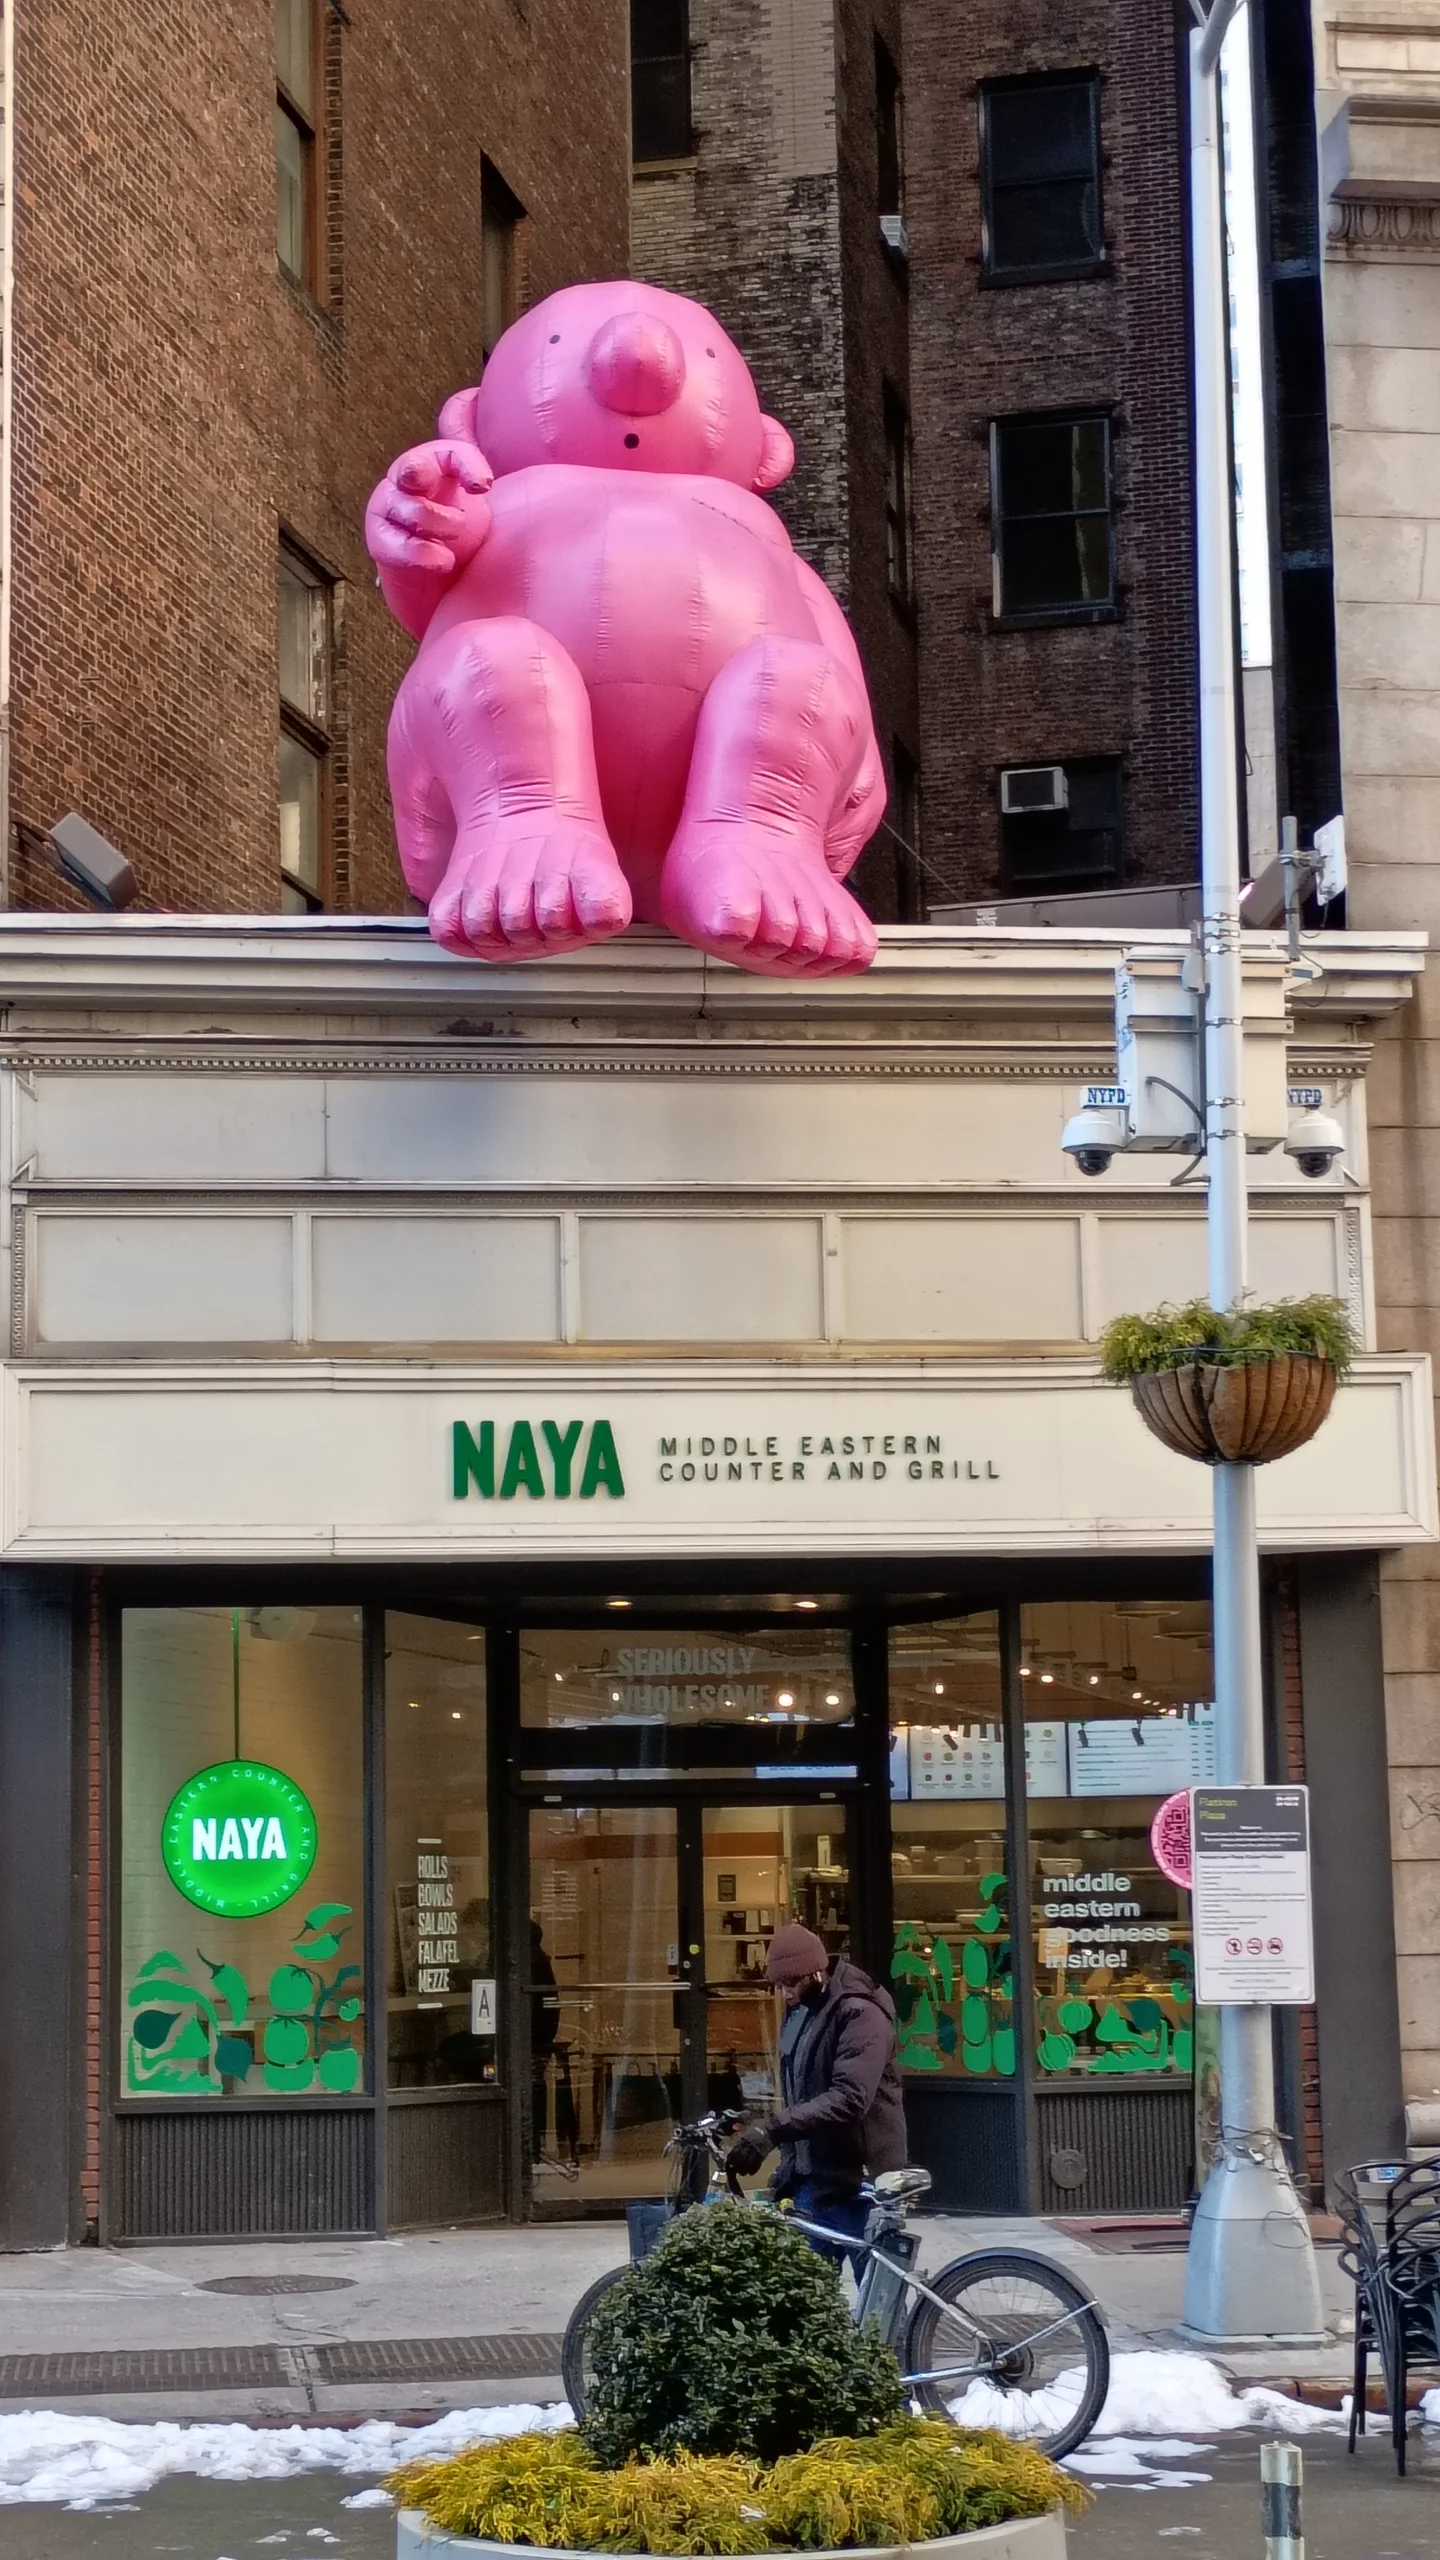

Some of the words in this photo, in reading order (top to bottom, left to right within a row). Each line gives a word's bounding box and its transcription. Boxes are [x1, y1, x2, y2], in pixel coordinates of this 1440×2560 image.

[1087, 1087, 1126, 1104] NYPD
[659, 1437, 779, 1456] MIDDLE
[801, 1436, 942, 1456] EASTERN
[453, 1420, 625, 1499] NAYA
[659, 1461, 806, 1481] COUNTER
[827, 1461, 887, 1480] AND
[908, 1460, 1001, 1479] GRILL
[617, 1647, 756, 1676] SERIOUSLY
[192, 1817, 287, 1861] NAYA
[418, 1856, 448, 1879] ROLLS
[1043, 1873, 1131, 1892] middle
[418, 1884, 453, 1907] BOWLS
[1044, 1900, 1140, 1918] eastern
[418, 1912, 458, 1935] SALADS
[1045, 1924, 1170, 1947] goodness
[418, 1940, 460, 1963] FALAFEL
[1045, 1948, 1128, 1969] inside!
[418, 1968, 450, 1993] MEZZE
[479, 1986, 490, 2019] A
